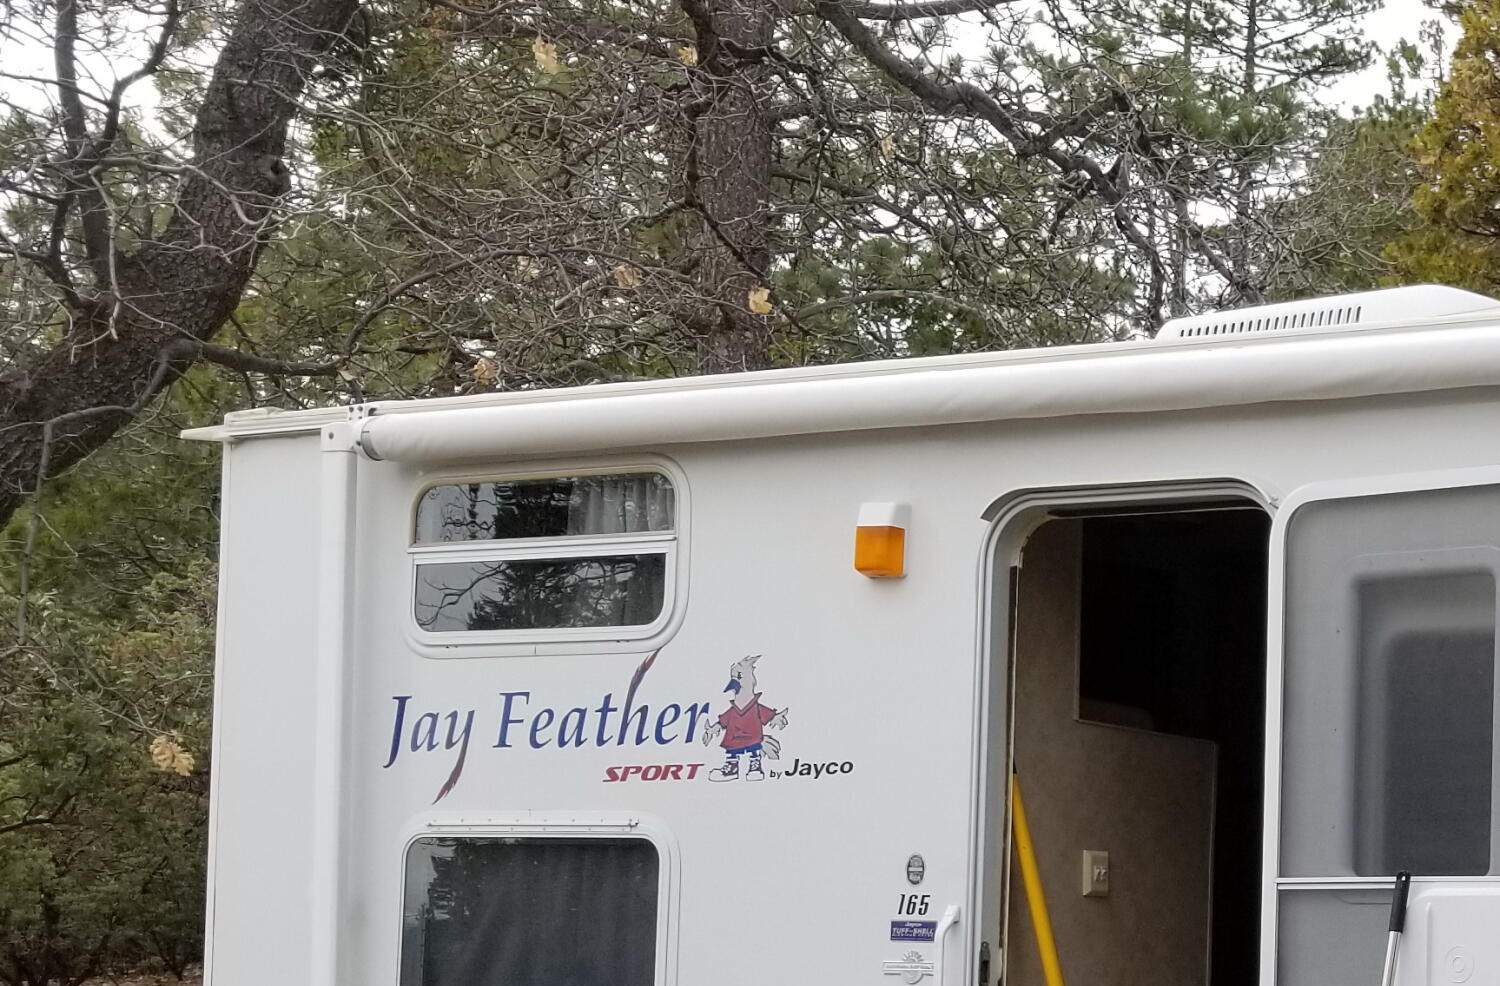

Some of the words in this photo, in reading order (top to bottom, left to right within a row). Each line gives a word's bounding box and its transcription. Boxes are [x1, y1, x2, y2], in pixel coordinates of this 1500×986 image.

[383, 695, 476, 805] Jay
[492, 645, 710, 750] Feather
[602, 763, 704, 783] SPORT
[769, 769, 782, 780] by
[784, 758, 854, 780] Jayco
[898, 893, 931, 916] 165
